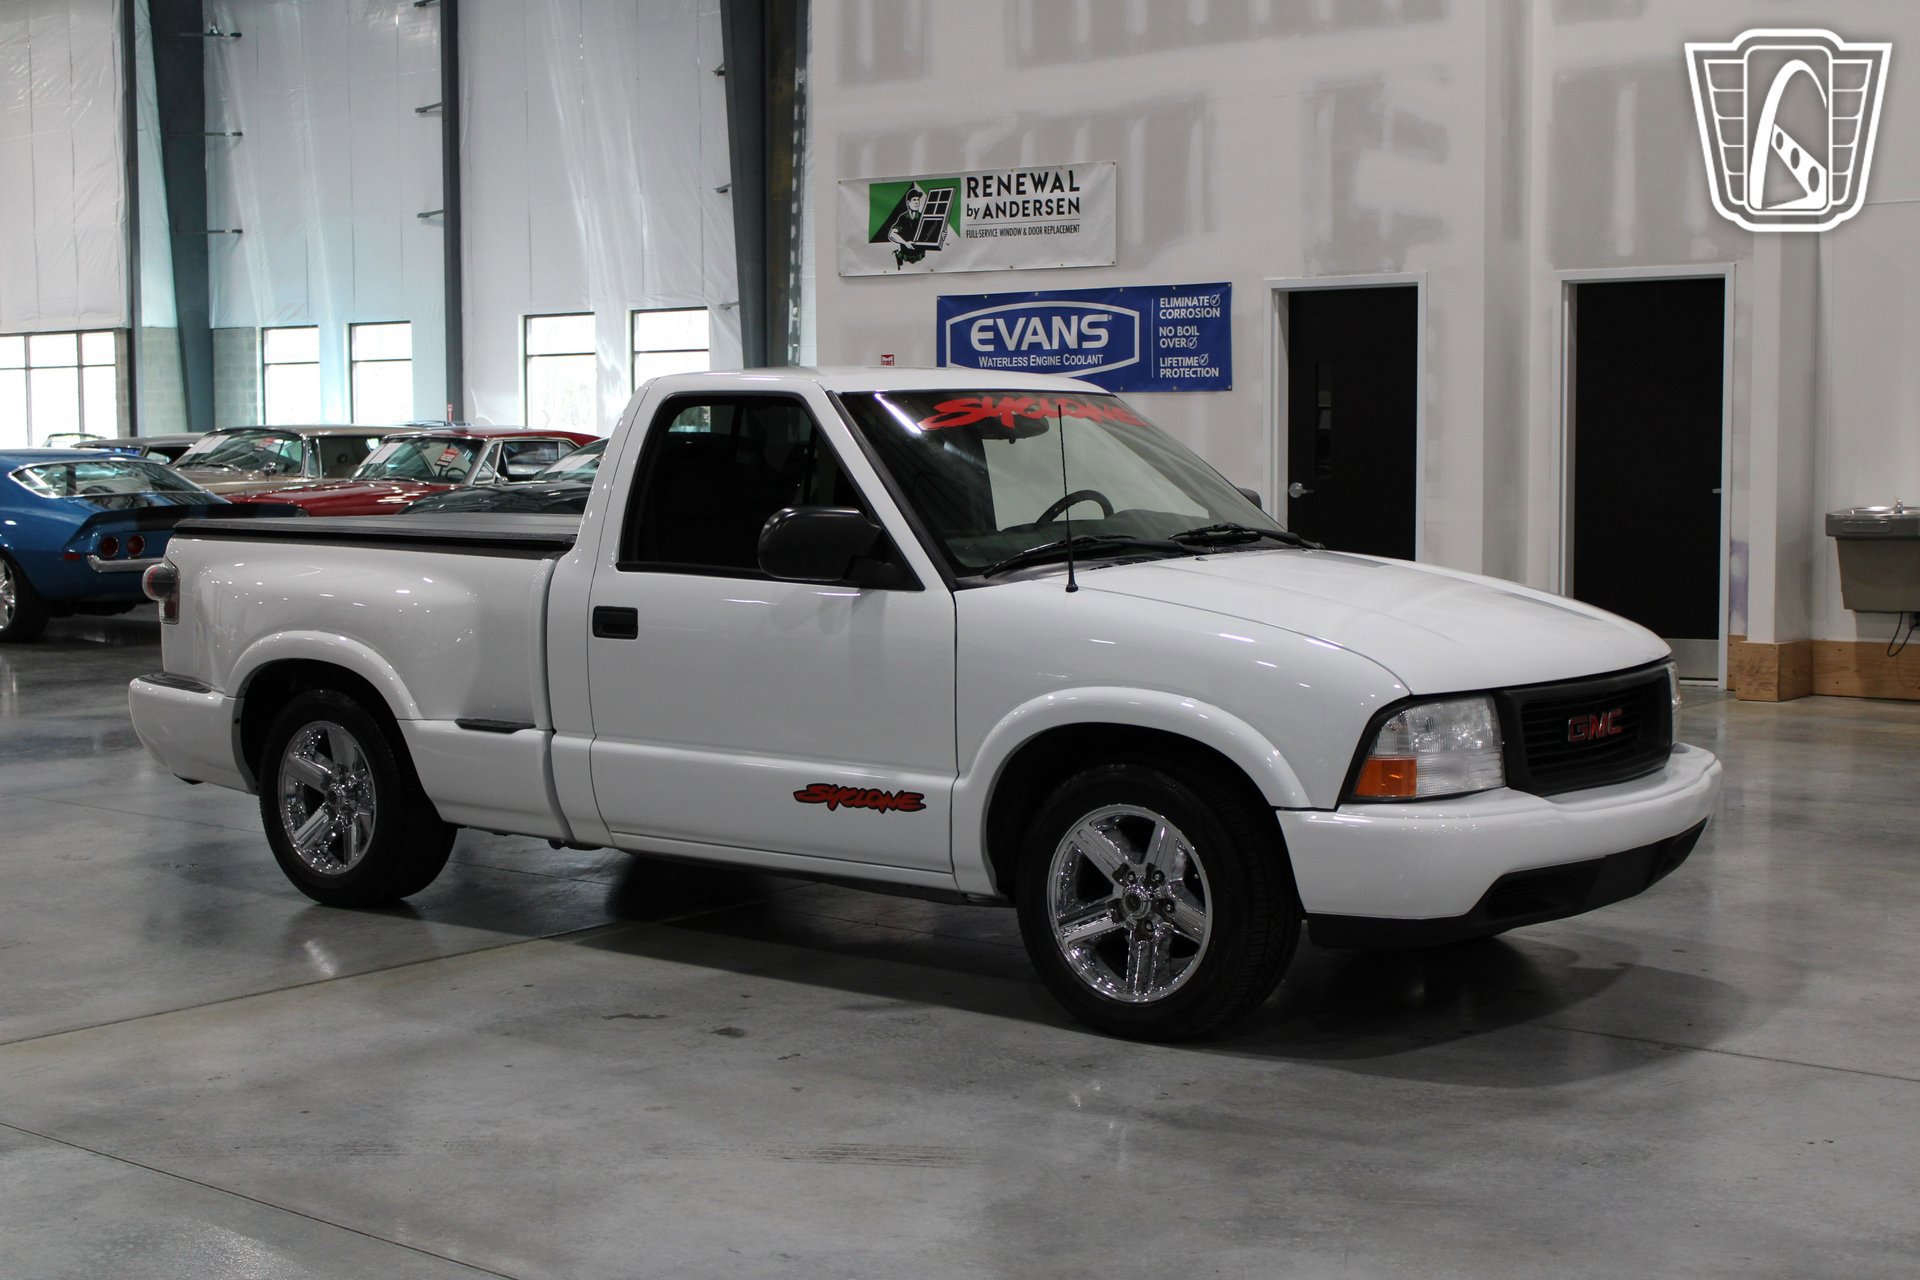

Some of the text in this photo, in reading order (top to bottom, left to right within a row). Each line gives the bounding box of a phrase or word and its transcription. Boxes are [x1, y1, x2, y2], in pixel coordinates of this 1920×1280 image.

[966, 170, 1080, 198] RENEWAL
[966, 197, 1080, 220] by ANDERSEN
[1000, 227, 1022, 237] WINDOW
[1023, 227, 1027, 236] &
[1028, 226, 1042, 236] DOOR
[1044, 224, 1080, 235] REPLACEMENT
[1160, 296, 1210, 308] ELIMINATE
[1159, 307, 1220, 319] CORROSION
[970, 314, 1109, 352] EVANS
[1159, 326, 1200, 337] NO BOIL
[1160, 337, 1187, 348] OVER
[1160, 356, 1199, 367] LIFETIME
[1160, 367, 1219, 378] PROTECTION
[1568, 707, 1623, 743] GMC
